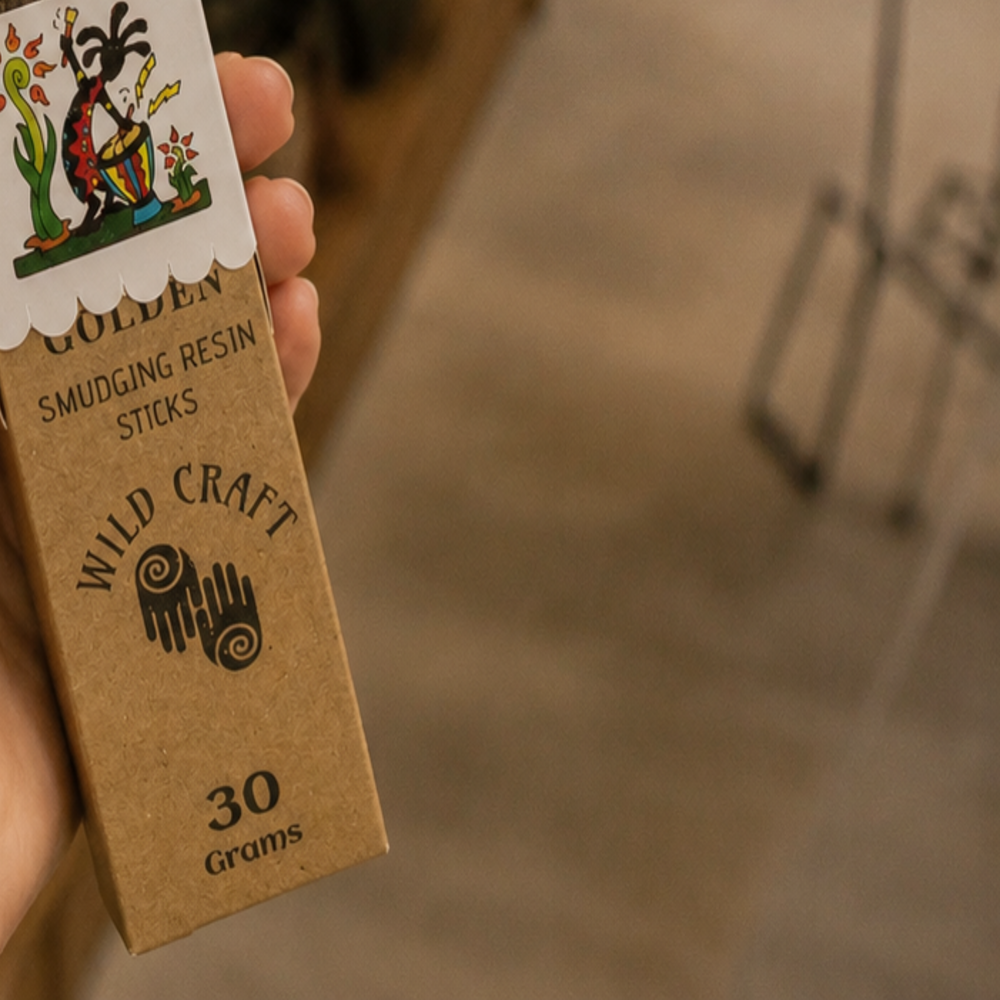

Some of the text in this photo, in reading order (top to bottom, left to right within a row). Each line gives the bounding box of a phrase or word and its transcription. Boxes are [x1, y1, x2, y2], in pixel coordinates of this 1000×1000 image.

[38, 318, 257, 423] SMUDGING RESIN
[116, 388, 199, 441] STICKS
[76, 462, 299, 593] WILD CRAFT
[206, 769, 281, 831] 30
[204, 823, 303, 876] Grams
